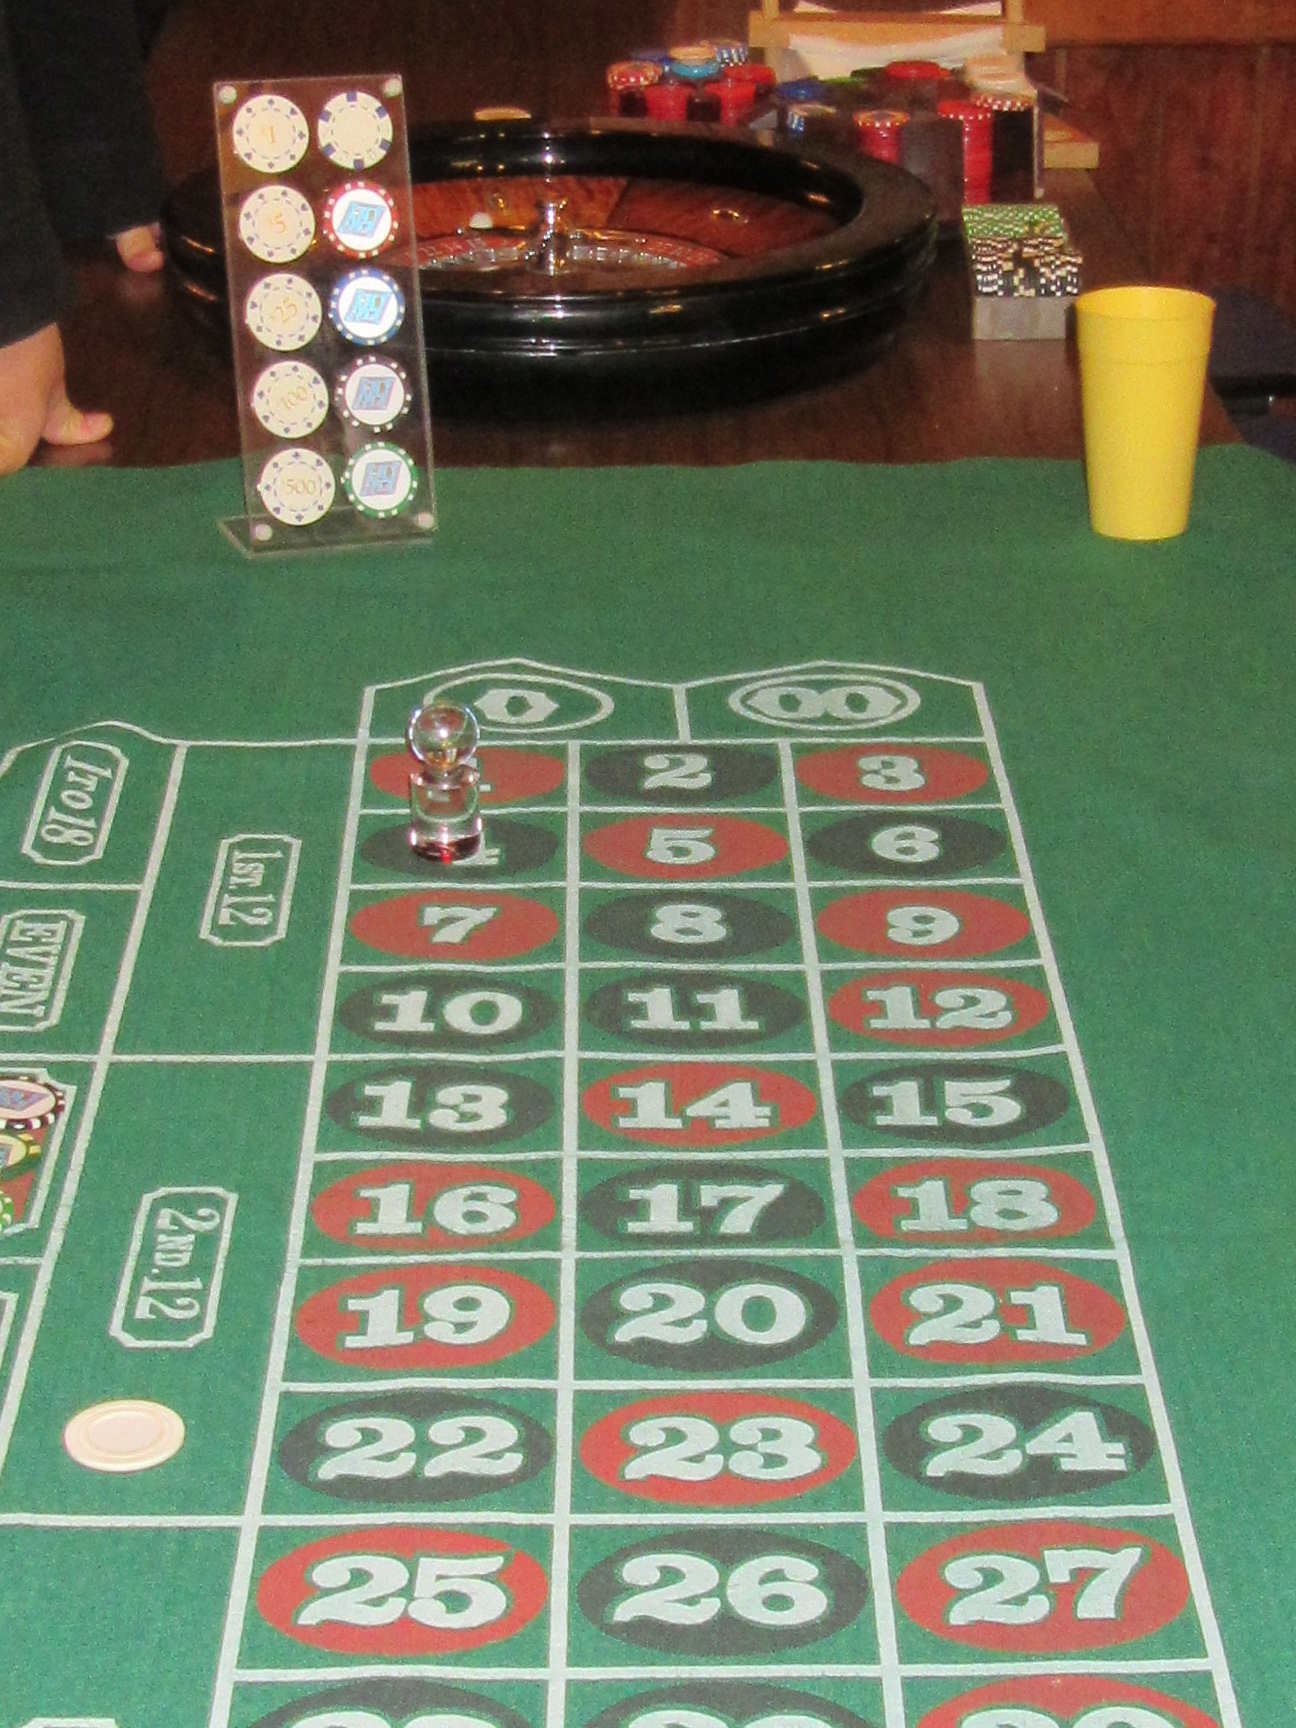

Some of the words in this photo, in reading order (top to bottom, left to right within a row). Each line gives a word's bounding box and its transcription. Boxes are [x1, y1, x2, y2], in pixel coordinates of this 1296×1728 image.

[473, 688, 560, 724] 0
[750, 683, 900, 723] 00
[644, 754, 712, 789] 2
[858, 755, 925, 791] 3
[647, 828, 715, 864] 5
[872, 825, 939, 862] 6
[423, 906, 496, 943] 7
[651, 904, 726, 943] 8
[887, 906, 960, 945] 9
[374, 990, 522, 1034] 10
[628, 987, 759, 1030] 11
[867, 986, 1012, 1029] 12
[358, 1080, 508, 1131] 13
[618, 1082, 771, 1128] 14
[873, 1080, 1021, 1126] 15
[355, 1184, 517, 1235] 16
[628, 1184, 783, 1233] 17
[898, 1180, 1058, 1231] 18
[345, 1285, 510, 1348] 19
[614, 1283, 806, 1344] 20
[909, 1284, 1087, 1345] 21
[318, 1416, 523, 1480] 22
[624, 1417, 821, 1481] 23
[926, 1412, 1127, 1476] 24
[297, 1555, 506, 1629] 25
[613, 1554, 828, 1626] 26
[945, 1547, 1142, 1625] 27
